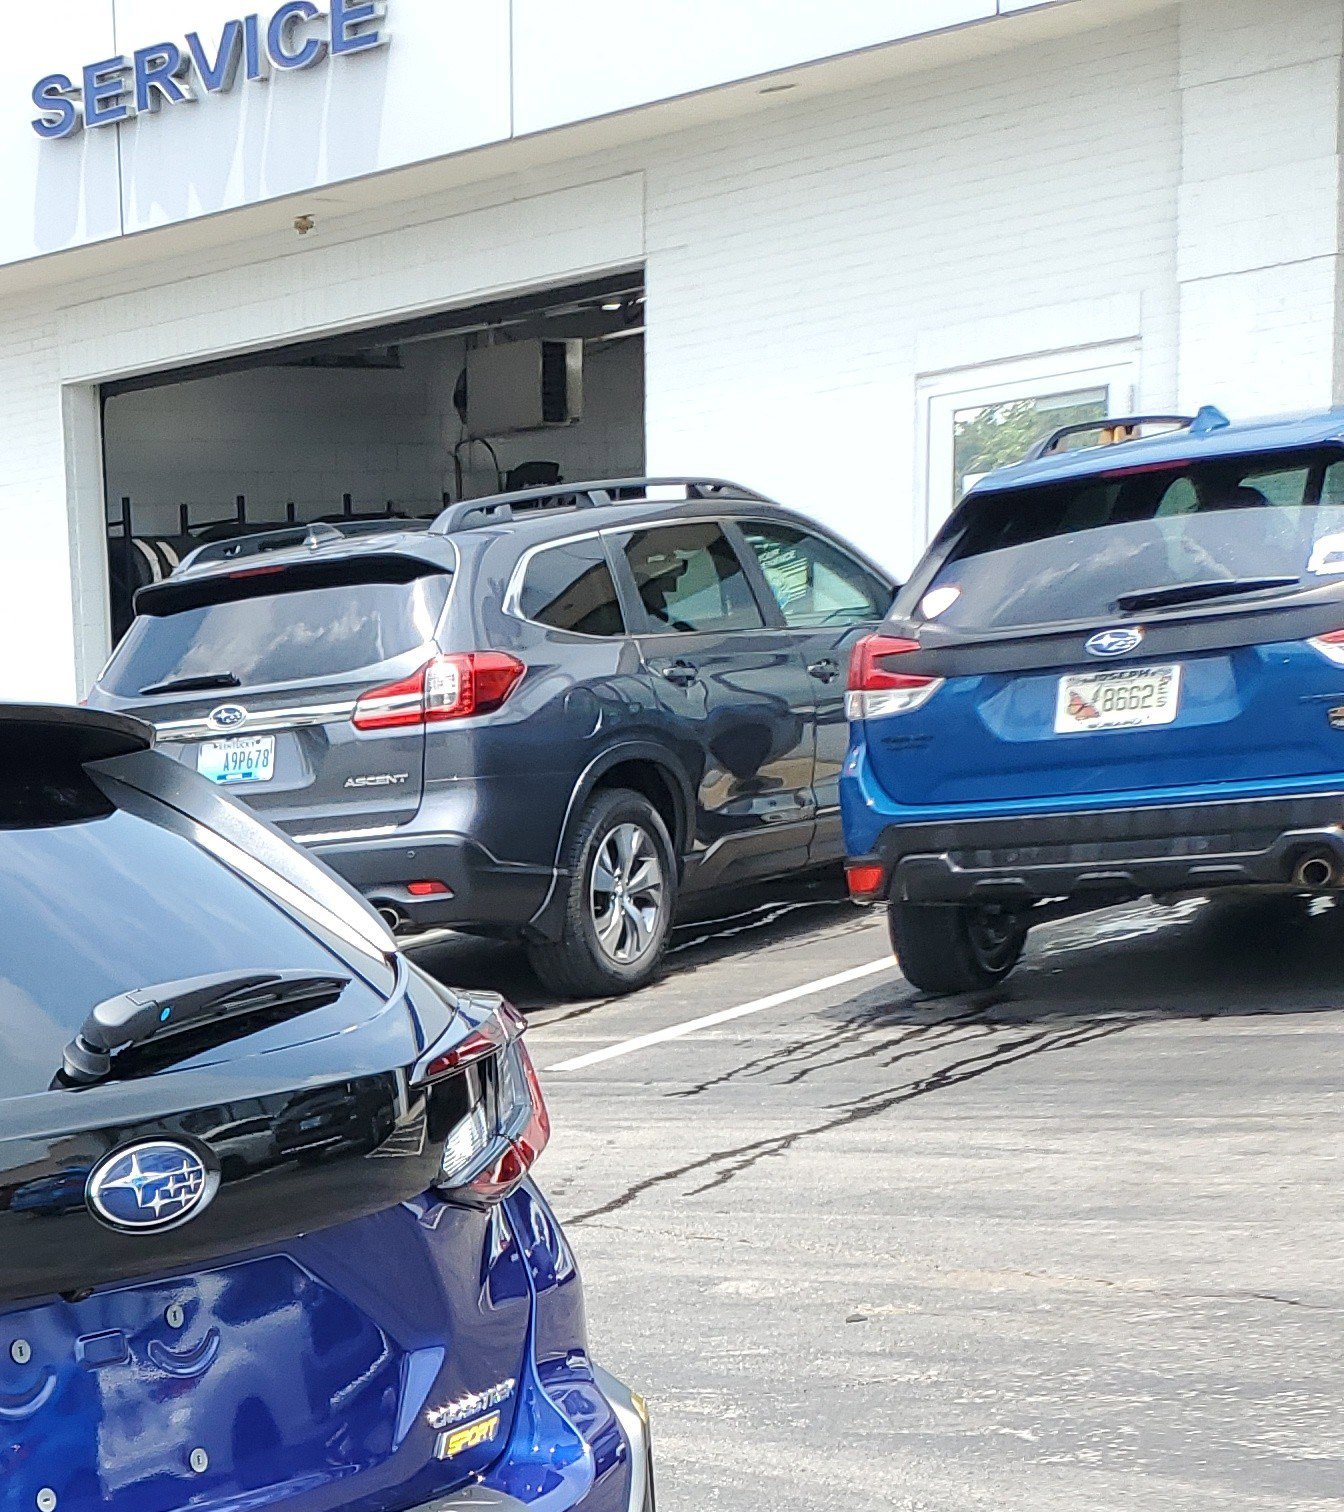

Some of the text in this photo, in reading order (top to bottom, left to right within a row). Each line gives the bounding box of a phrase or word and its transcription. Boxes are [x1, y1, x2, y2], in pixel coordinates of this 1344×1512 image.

[31, 0, 392, 140] SERVICE
[1103, 684, 1155, 712] 8662
[223, 748, 270, 772] A9P678
[344, 772, 409, 788] ASCENT
[446, 1415, 500, 1457] SPORT
